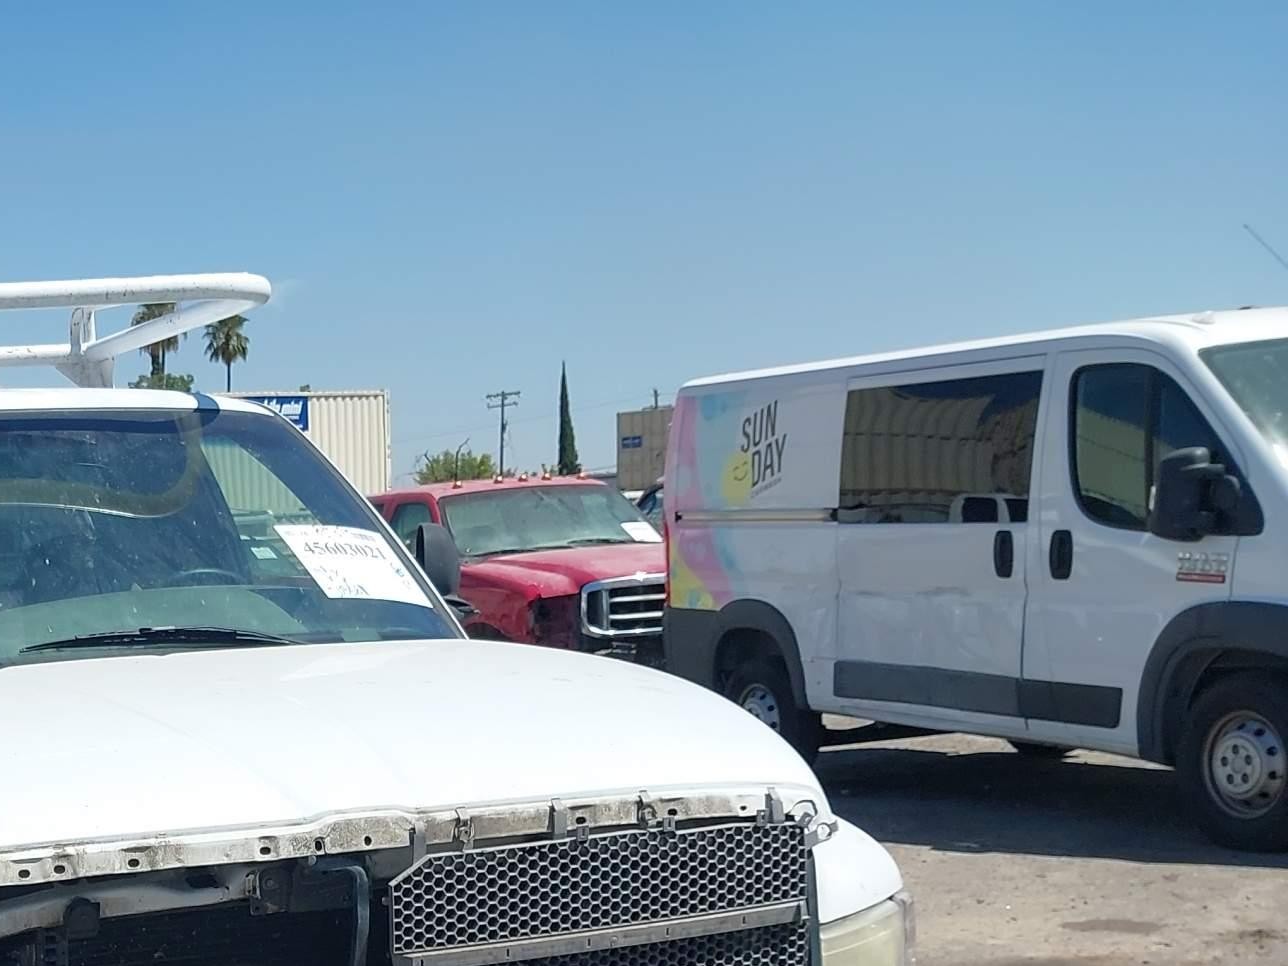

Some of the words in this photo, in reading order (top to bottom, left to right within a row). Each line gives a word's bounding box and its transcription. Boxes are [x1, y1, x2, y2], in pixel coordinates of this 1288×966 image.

[740, 399, 778, 453] SUN
[751, 433, 787, 488] DAY
[303, 541, 386, 560] 45603021
